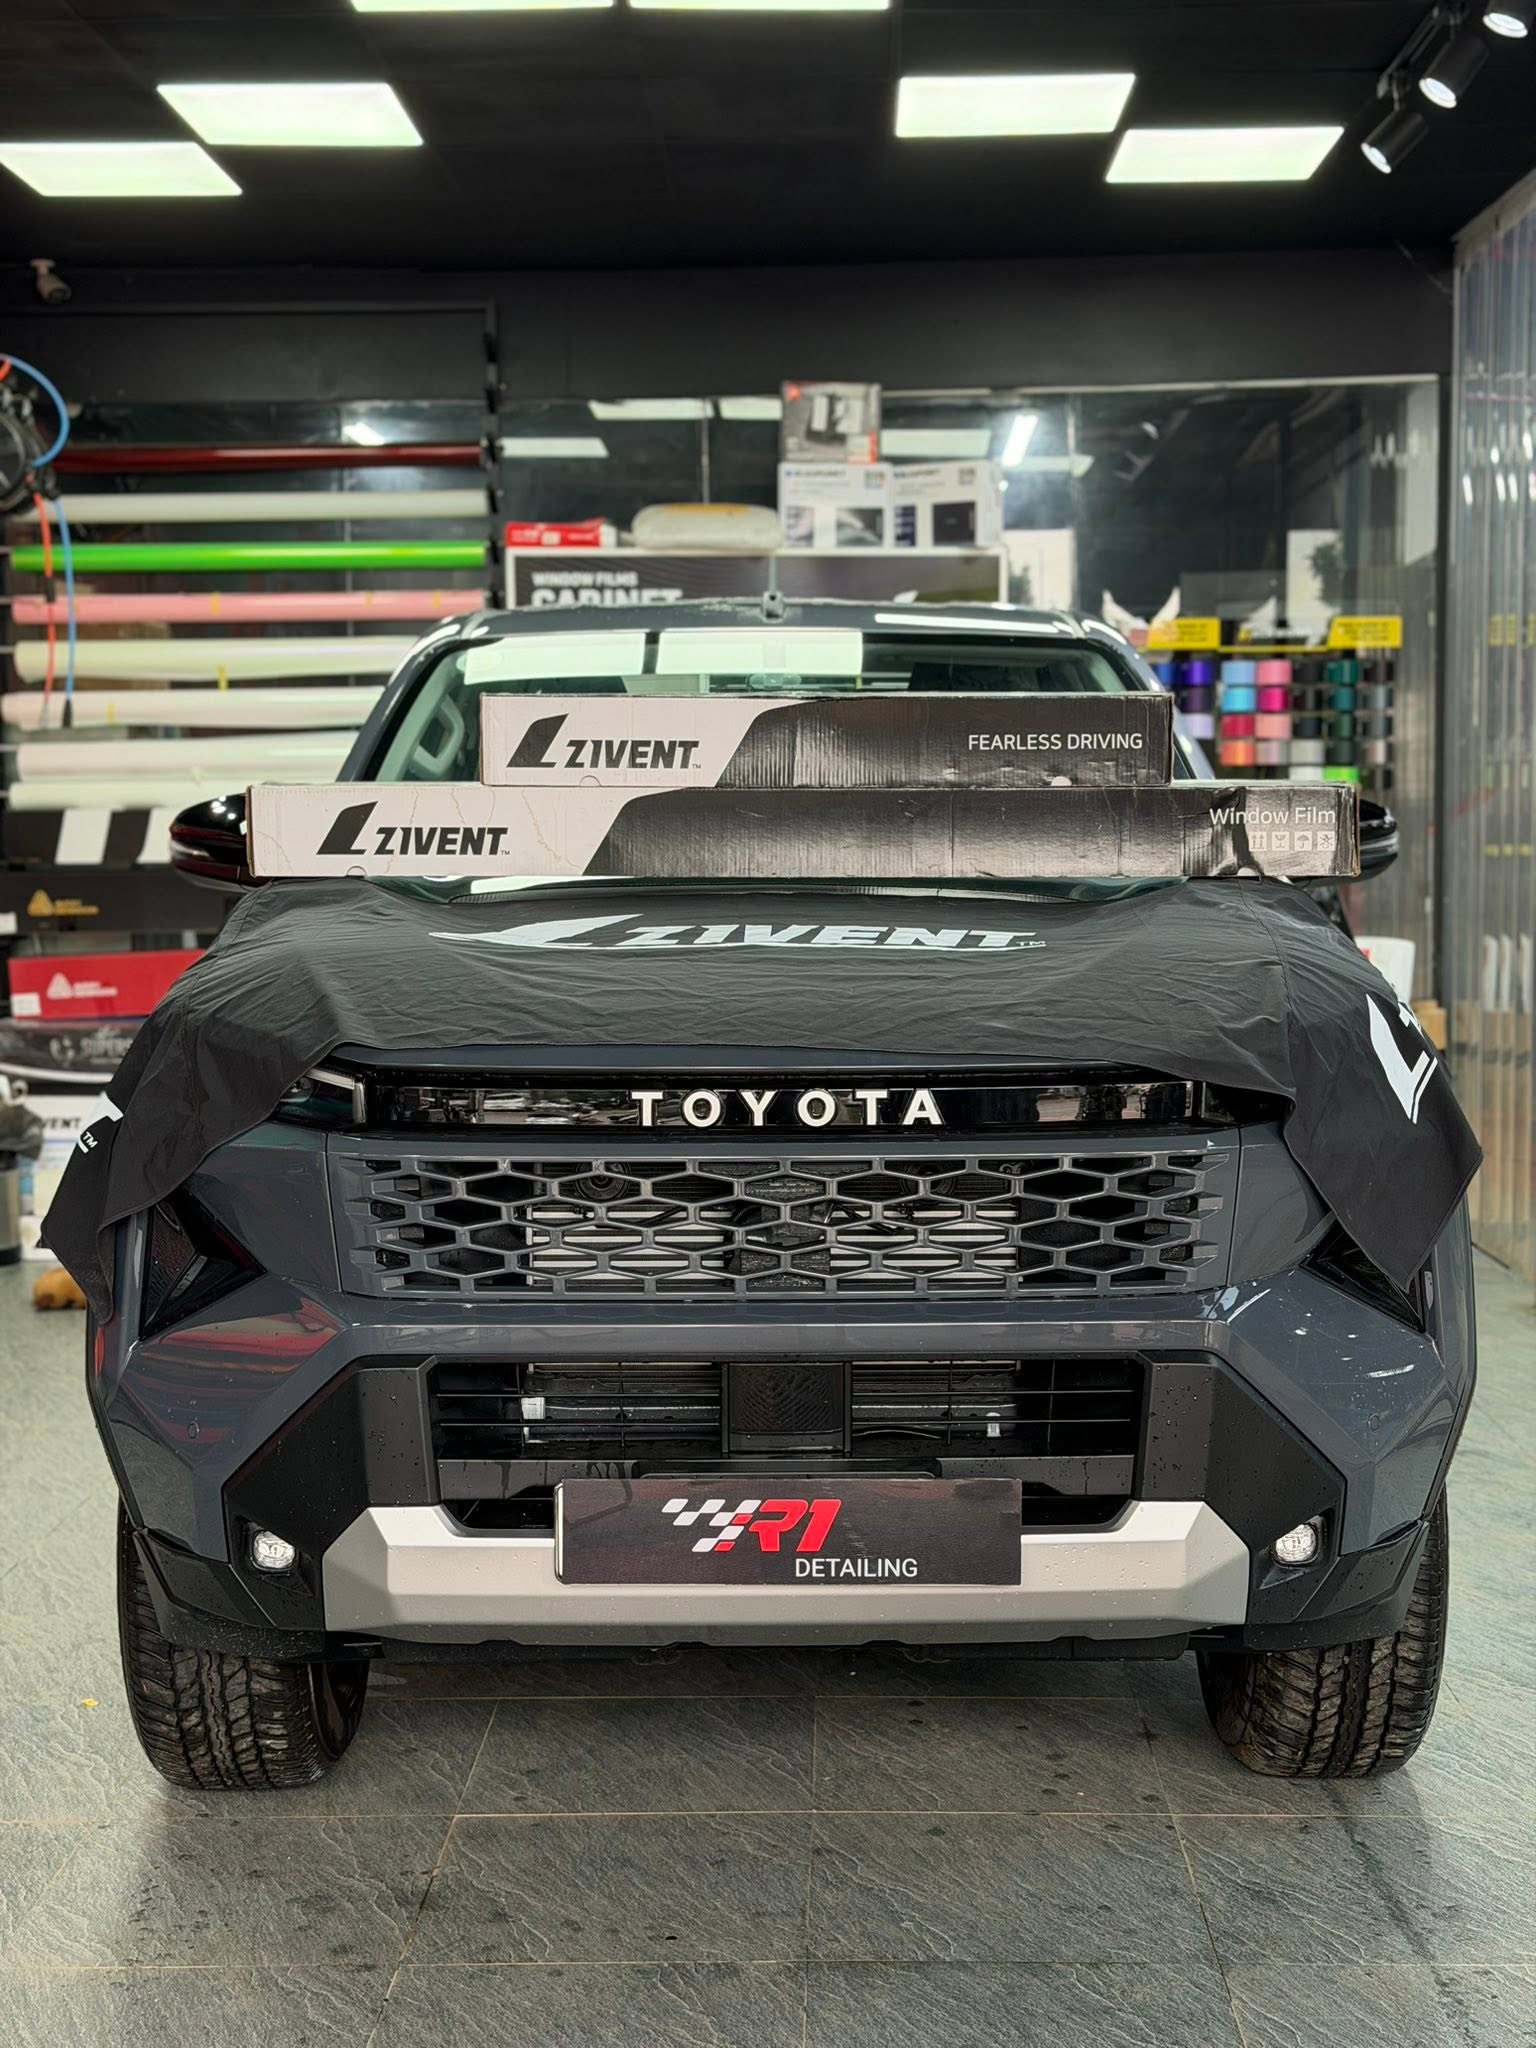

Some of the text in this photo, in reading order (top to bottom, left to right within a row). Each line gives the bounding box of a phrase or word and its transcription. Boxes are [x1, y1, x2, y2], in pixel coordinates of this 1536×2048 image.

[531, 570, 639, 587] WINDOW FILMS
[564, 739, 700, 769] ZIVENT
[968, 733, 1143, 751] FEARLESS DRIVING
[1209, 805, 1337, 825] Window Film
[374, 826, 509, 856] ZIVENT
[614, 923, 1037, 948] ZIVENT
[631, 1089, 943, 1127] TOYOTA
[748, 1498, 842, 1552] R1
[795, 1558, 919, 1578] DETAILING
